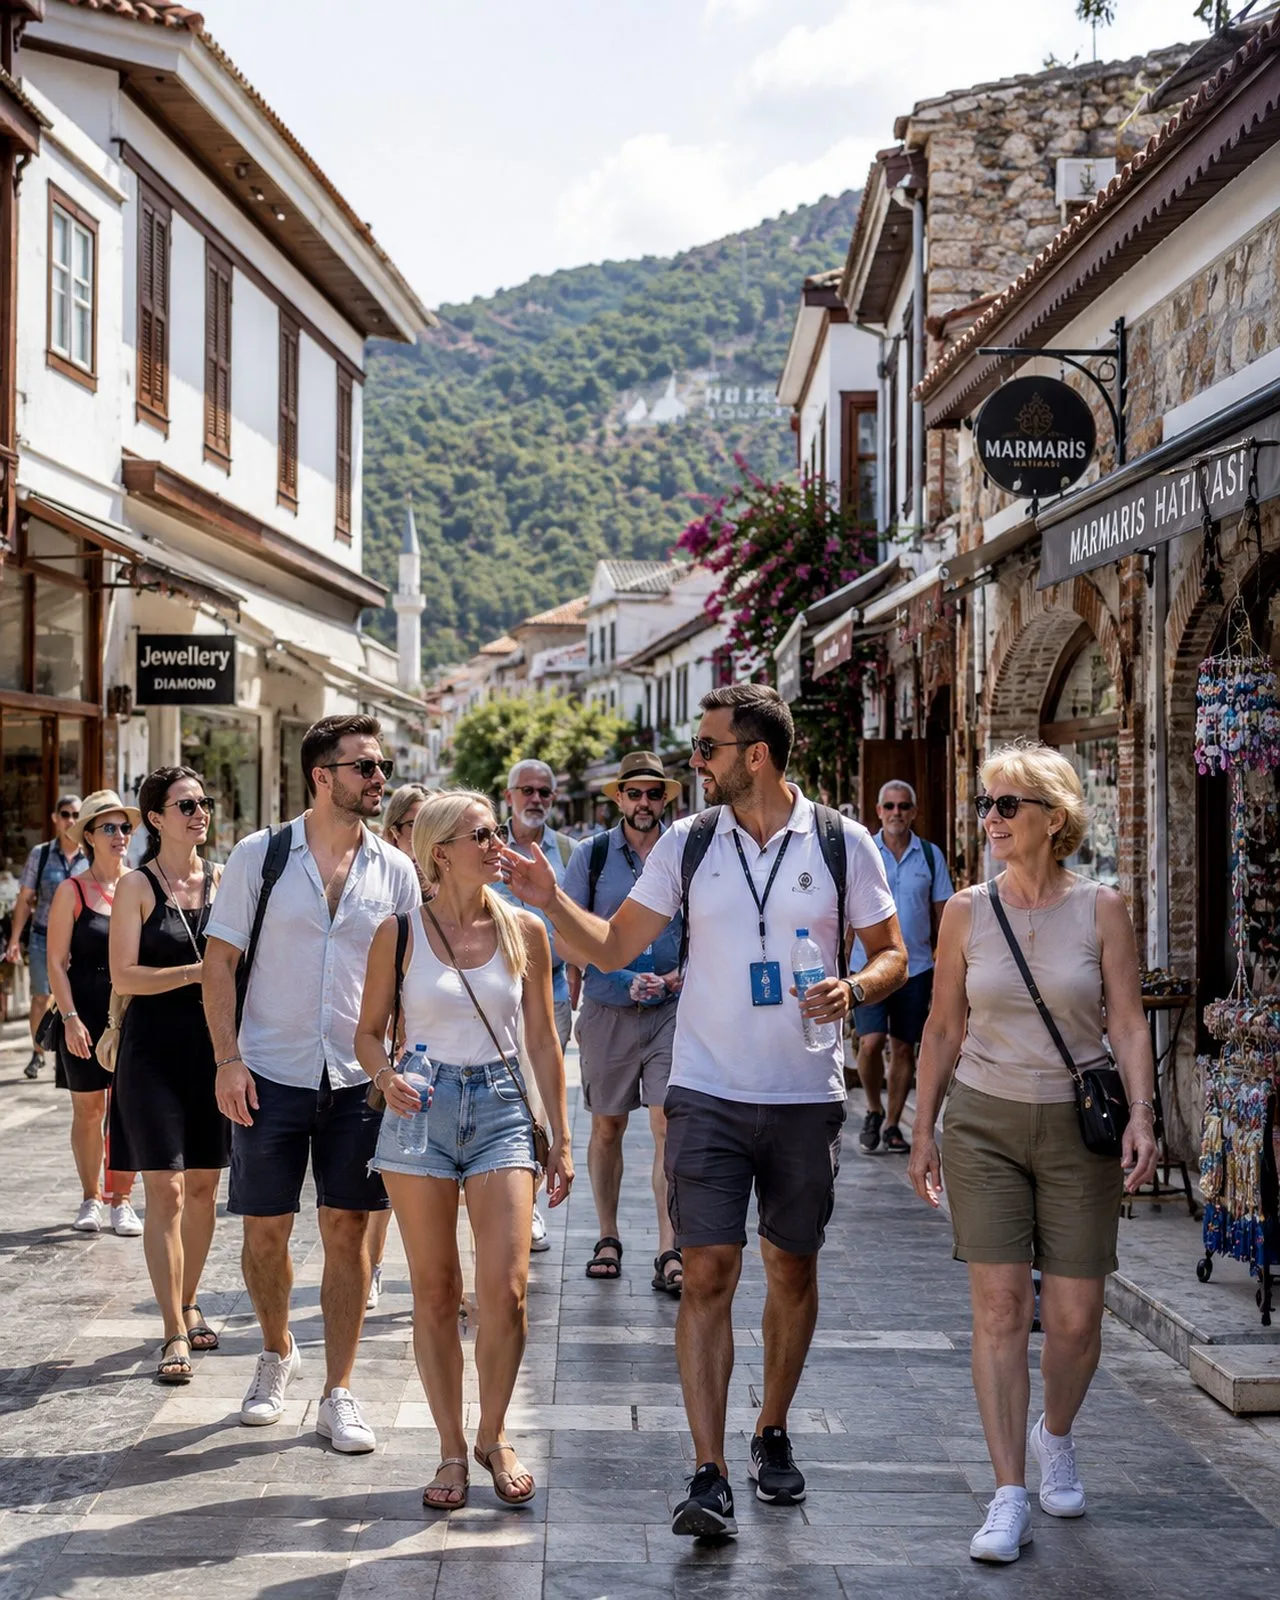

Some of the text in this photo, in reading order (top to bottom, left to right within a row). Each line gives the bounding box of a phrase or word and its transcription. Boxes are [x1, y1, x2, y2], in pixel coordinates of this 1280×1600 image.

[1069, 496, 1146, 565] MARMARIS
[140, 645, 231, 672] Jewellery
[154, 678, 217, 691] DIAMOND
